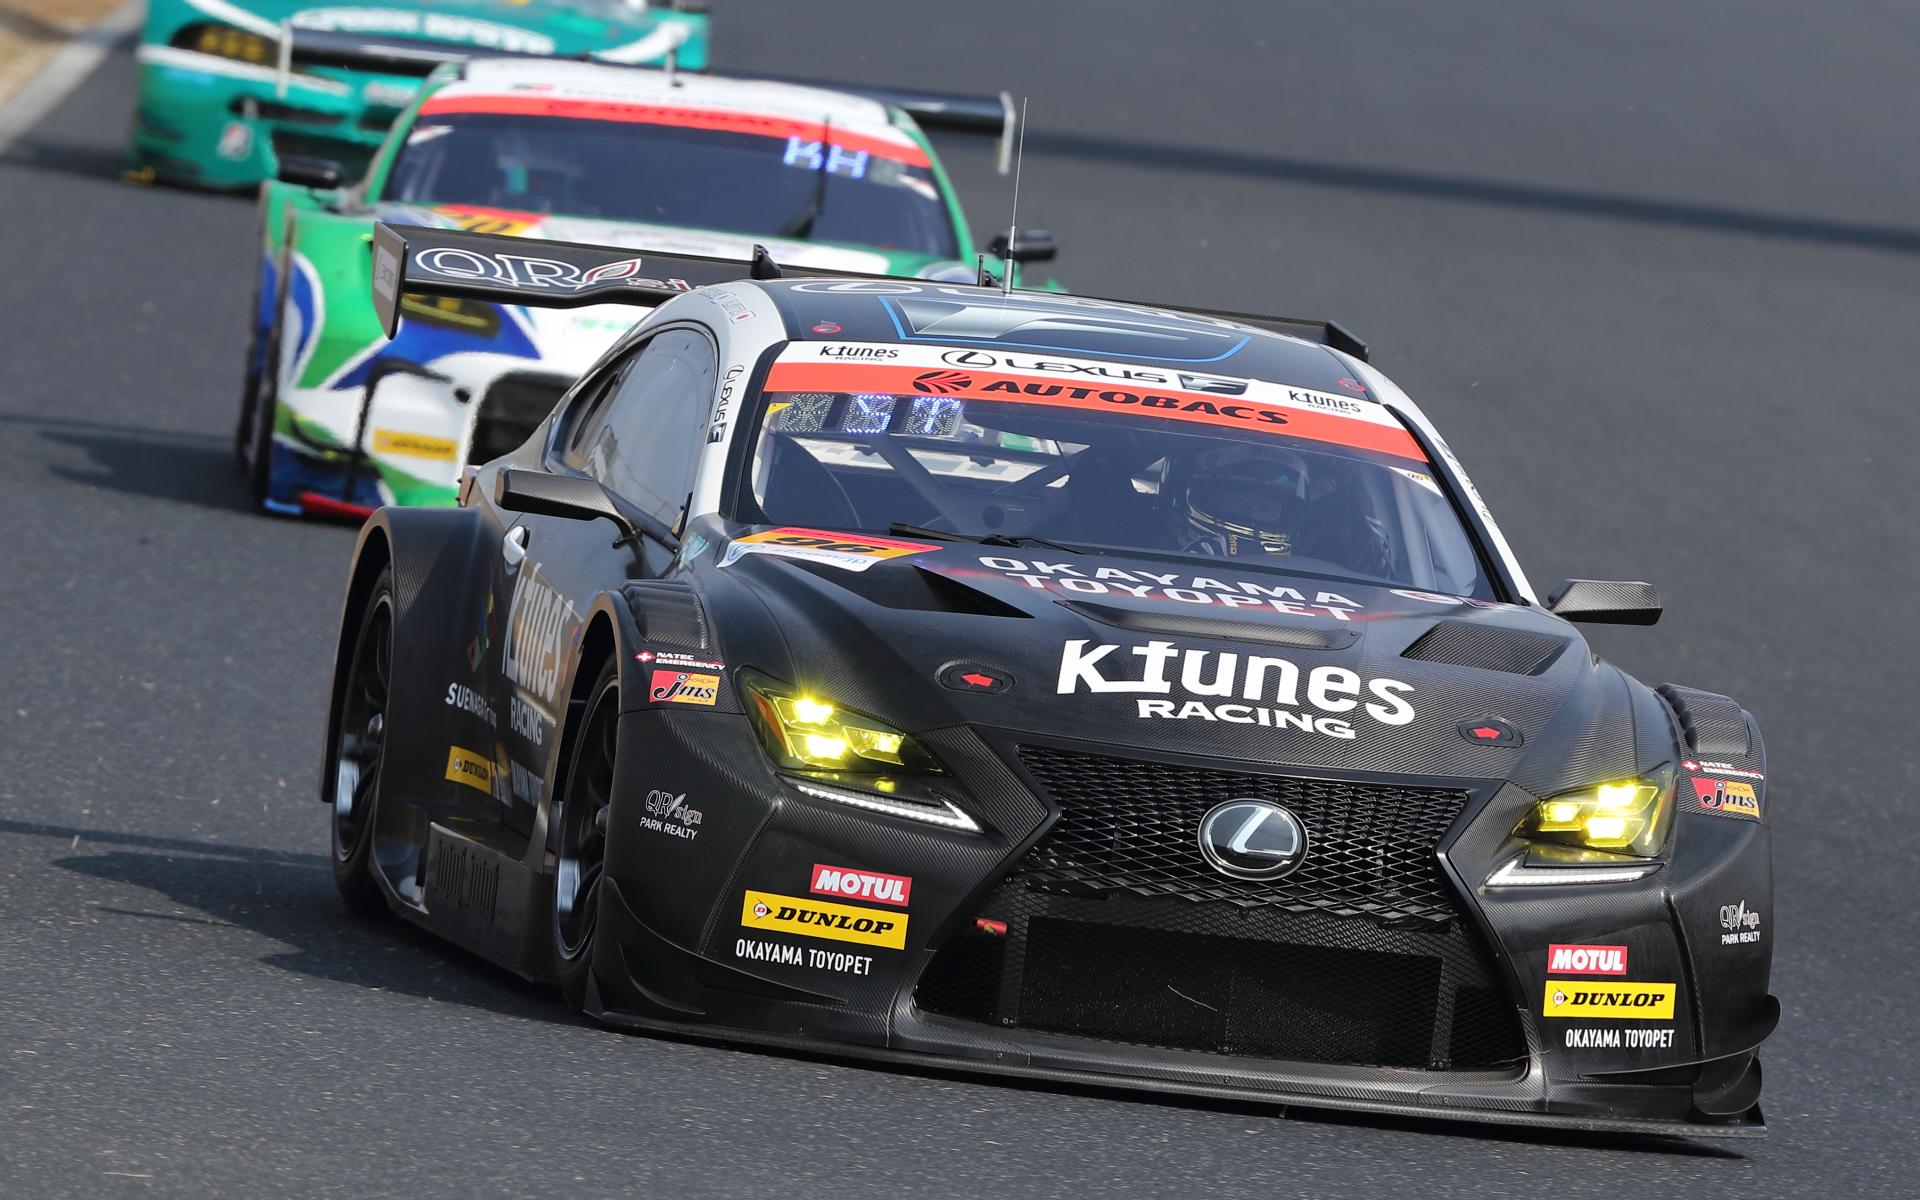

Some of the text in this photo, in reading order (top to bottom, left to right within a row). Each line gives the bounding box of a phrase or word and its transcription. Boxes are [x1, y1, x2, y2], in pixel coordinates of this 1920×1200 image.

[415, 247, 588, 290] QR
[1005, 358, 1168, 383] LEXUS
[713, 379, 735, 423] LEXUS
[979, 380, 1289, 424] AUTOBACS
[1307, 403, 1352, 415] RACING
[761, 536, 890, 554] 96
[978, 555, 1364, 608] OKAYAMA
[1006, 572, 1356, 622] TOYOPET
[655, 658, 725, 670] EMERGENCY
[656, 652, 695, 660] NATEC
[511, 696, 543, 746] RACING
[1136, 699, 1357, 739] RACING
[462, 760, 490, 781] DUNLOP
[1699, 760, 1734, 770] NATEC
[1702, 767, 1764, 780] EMERGENCY
[674, 804, 703, 826] sign
[640, 816, 698, 841] PARK REALTY
[815, 869, 905, 902] MOTUL
[774, 906, 894, 935] DUNLOP
[1742, 909, 1760, 930] sign
[1721, 931, 1761, 945] PARK REALTY
[735, 938, 873, 976] OKAYAMA TOYOPET
[1551, 949, 1624, 971] MOTUL
[1570, 992, 1665, 1007] DUNLOP
[1565, 1028, 1675, 1048] OKAYAMA TOYOPET
